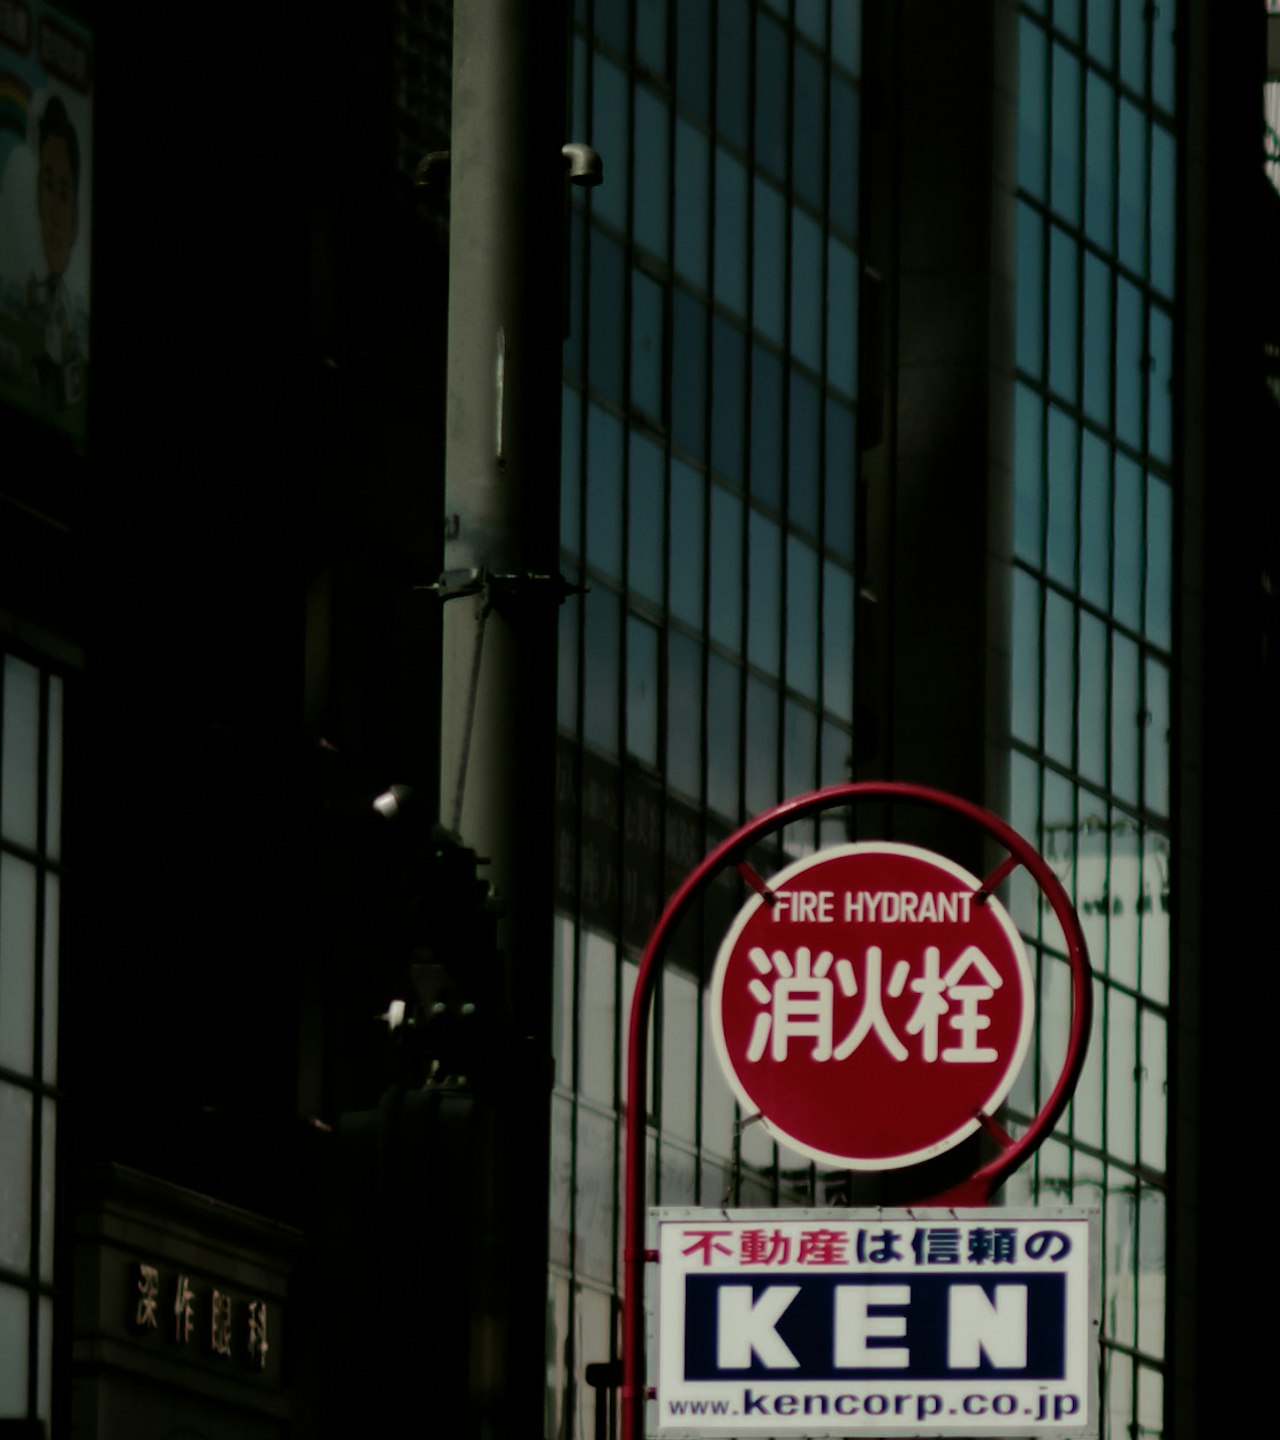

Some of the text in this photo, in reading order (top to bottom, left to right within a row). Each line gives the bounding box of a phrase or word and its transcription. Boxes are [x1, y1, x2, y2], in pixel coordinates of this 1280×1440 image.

[772, 890, 974, 924] FIRE HYDRANT
[746, 945, 1004, 1063] 消火栓
[681, 1227, 1073, 1266] 不動産は信頼の
[716, 1283, 1028, 1370] KEN
[668, 1388, 1080, 1423] www.kencorp.co.jp
